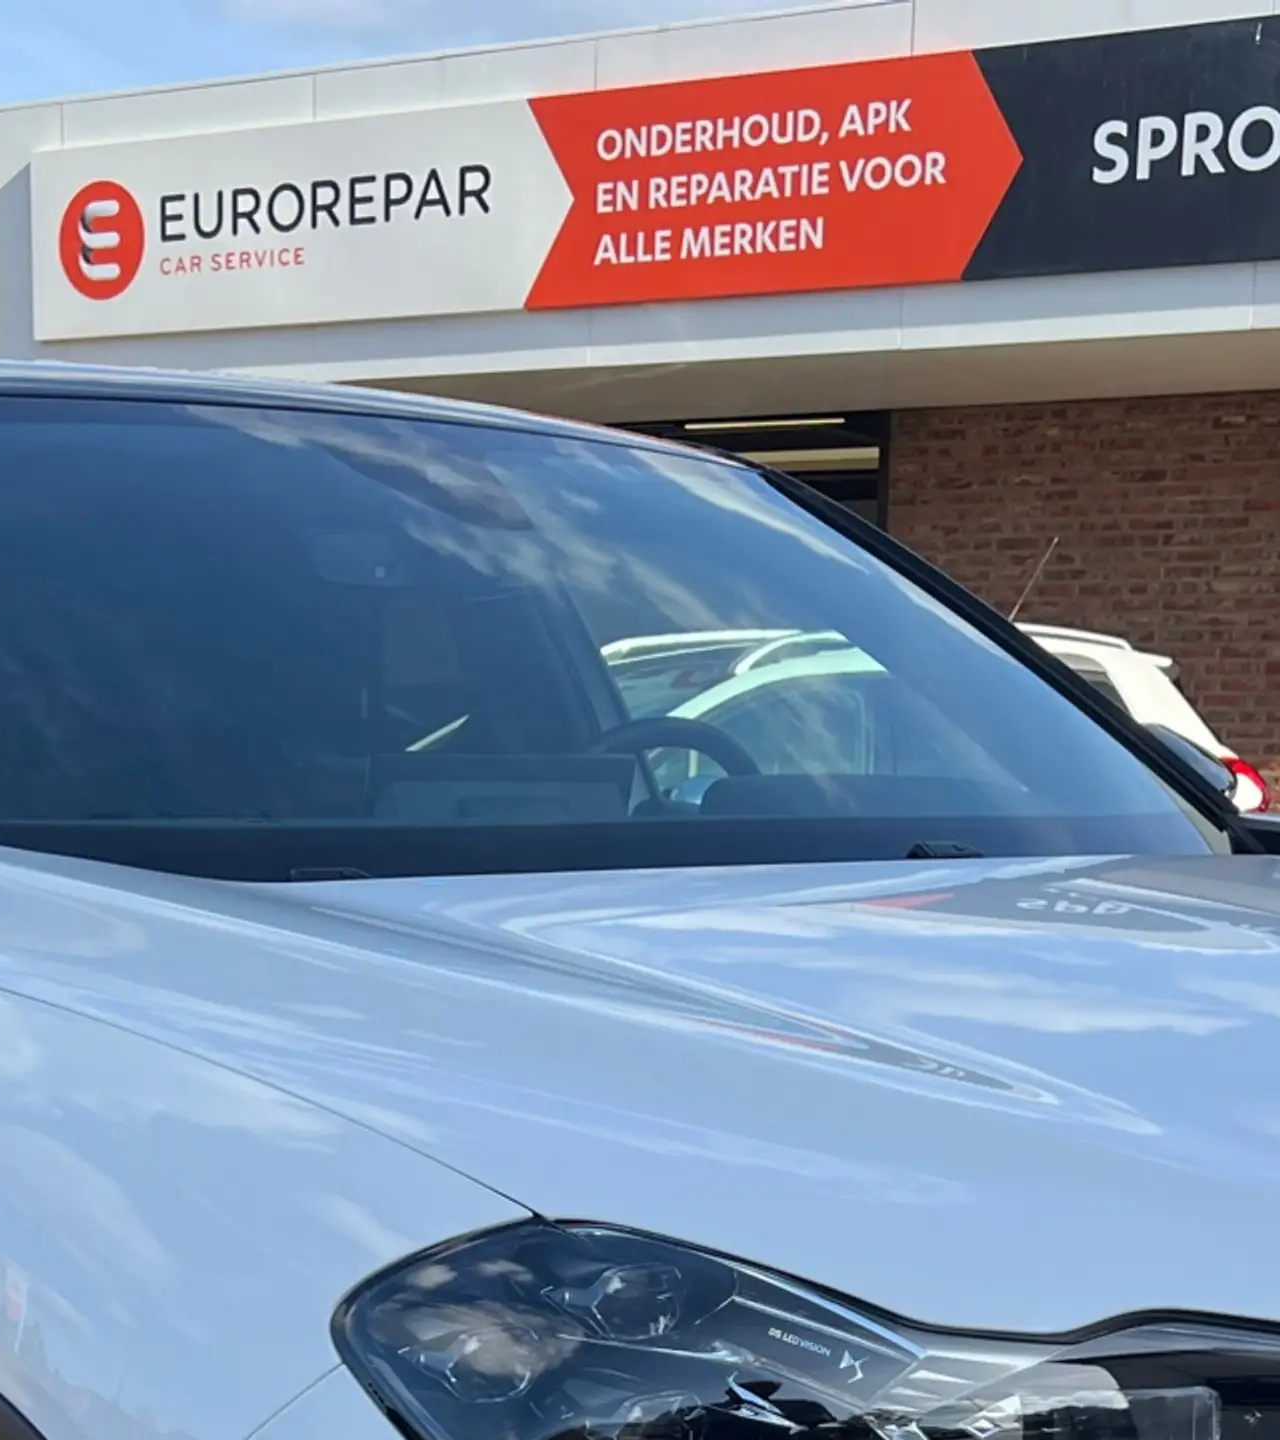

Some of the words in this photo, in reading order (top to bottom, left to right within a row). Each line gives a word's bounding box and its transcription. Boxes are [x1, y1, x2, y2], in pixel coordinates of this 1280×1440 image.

[596, 109, 830, 160] ONDERHOUD,
[838, 98, 913, 138] APK
[159, 163, 492, 243] EUROREPAR
[596, 180, 639, 214] EN
[648, 162, 831, 210] REPARATIE
[839, 152, 947, 192] VOOR
[160, 253, 205, 276] CAR
[211, 247, 305, 272] SERVICE
[593, 229, 672, 266] ALLE
[680, 218, 825, 260] MERKEN
